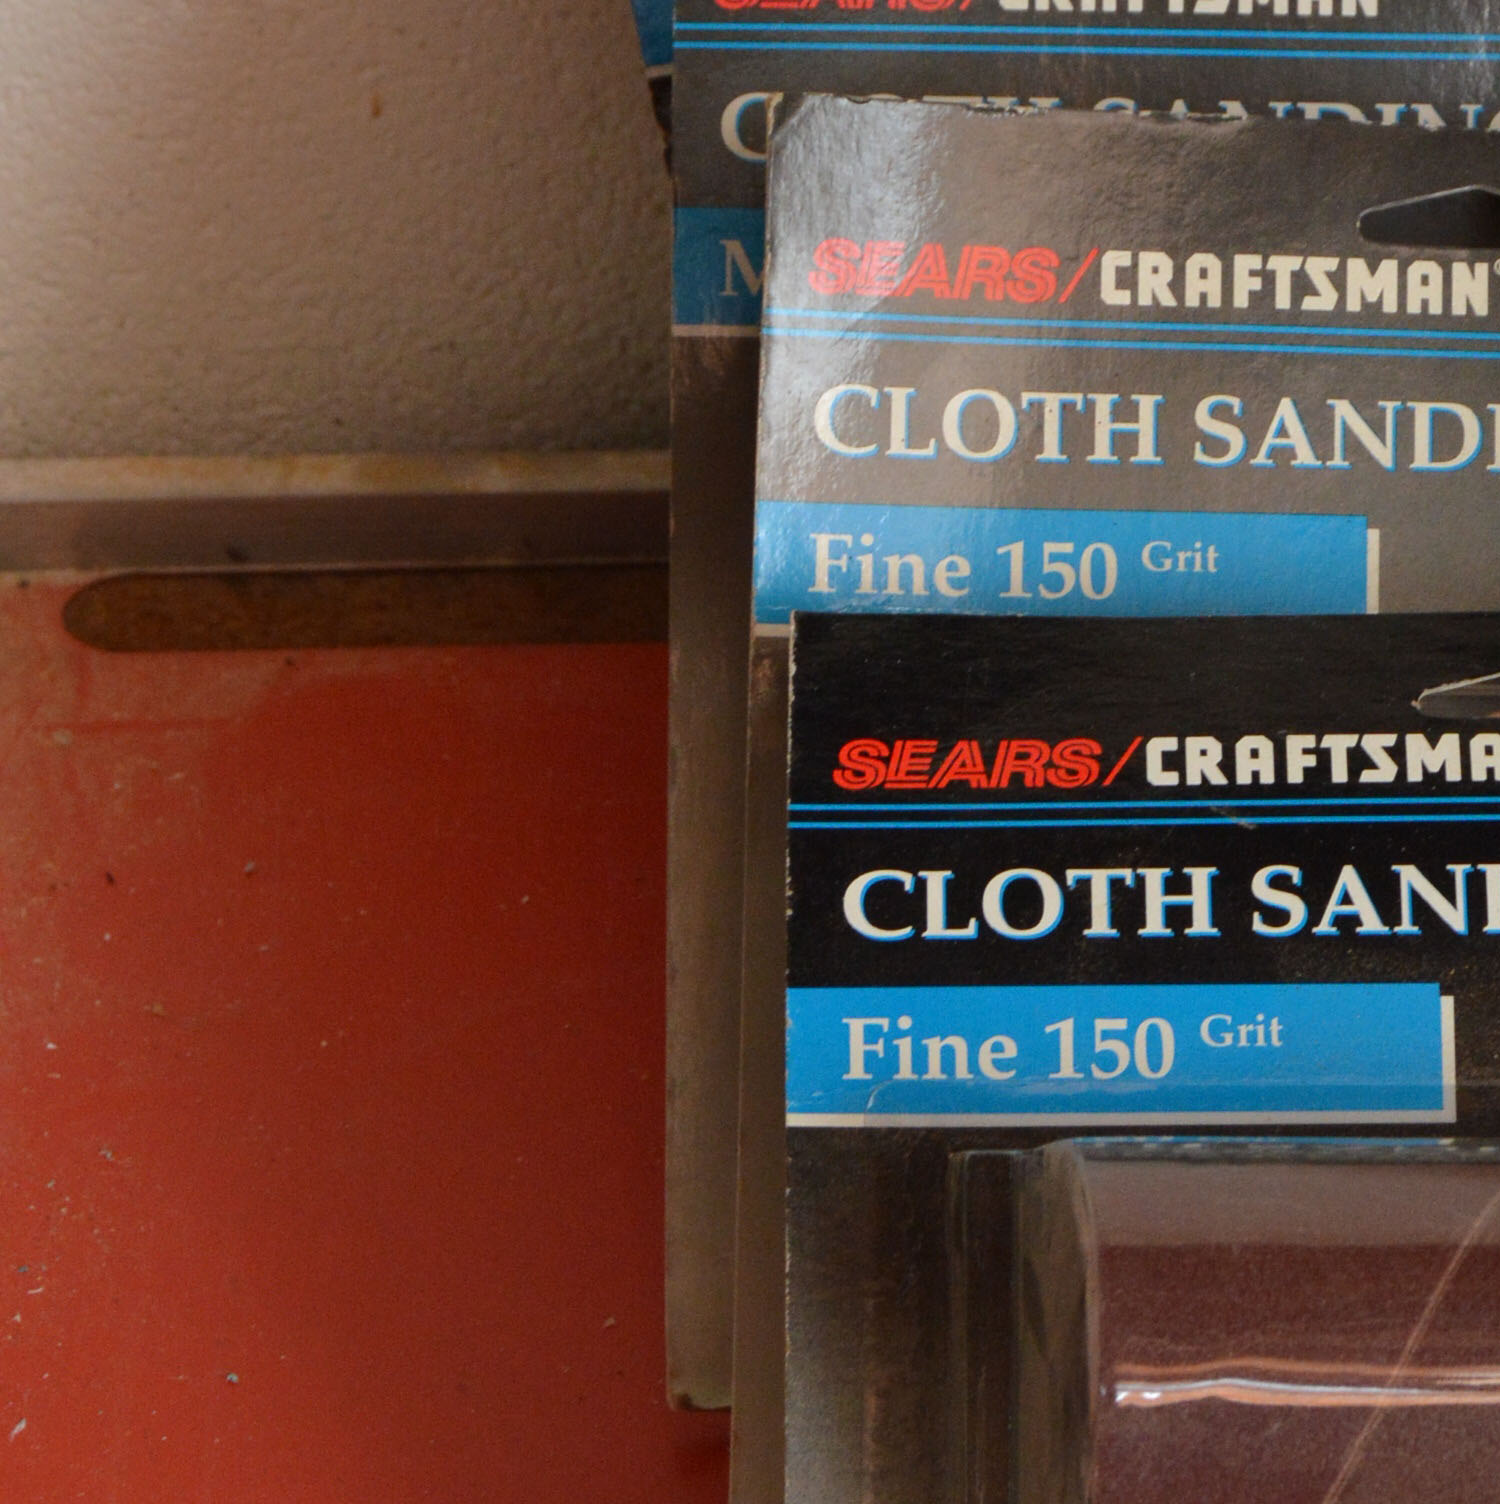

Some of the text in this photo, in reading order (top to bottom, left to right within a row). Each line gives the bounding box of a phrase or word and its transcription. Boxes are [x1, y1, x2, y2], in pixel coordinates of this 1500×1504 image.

[814, 383, 1164, 465] CLOTH
[809, 532, 1219, 600] Fine 150 Grit
[840, 864, 1224, 944] CLOTH
[842, 1013, 1283, 1081] Fine 150 Grit
